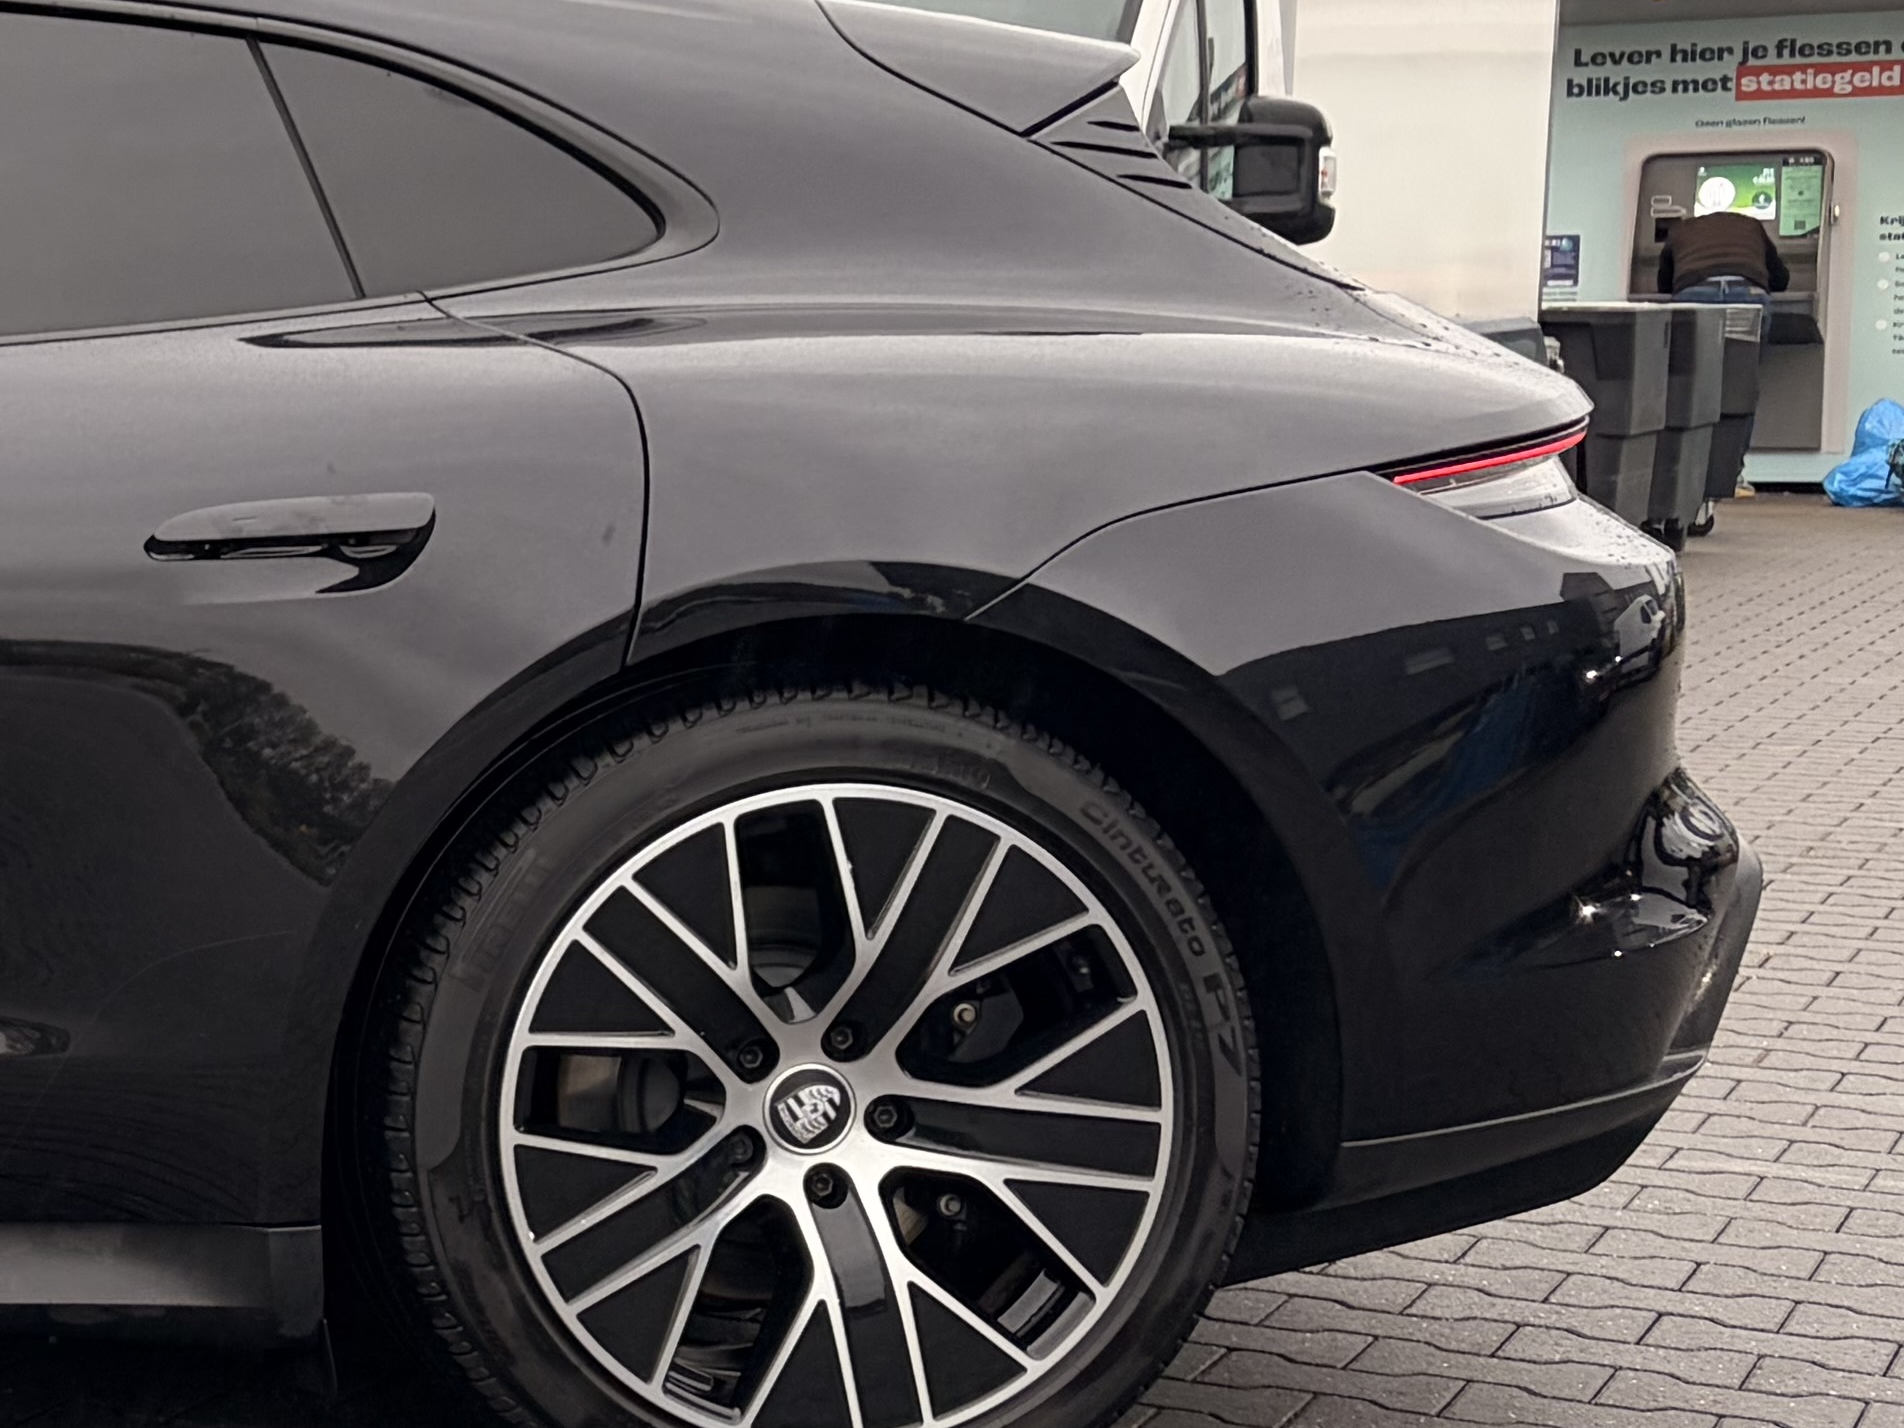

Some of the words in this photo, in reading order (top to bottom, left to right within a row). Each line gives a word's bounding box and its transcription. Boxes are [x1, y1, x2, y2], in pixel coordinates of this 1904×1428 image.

[1574, 48, 1662, 68] Lever
[1670, 42, 1734, 63] hier
[1738, 40, 1768, 66] je
[1775, 38, 1893, 59] flessen
[1566, 76, 1666, 102] blikjes
[1672, 74, 1733, 94] met
[1740, 65, 1901, 94] statiegeld
